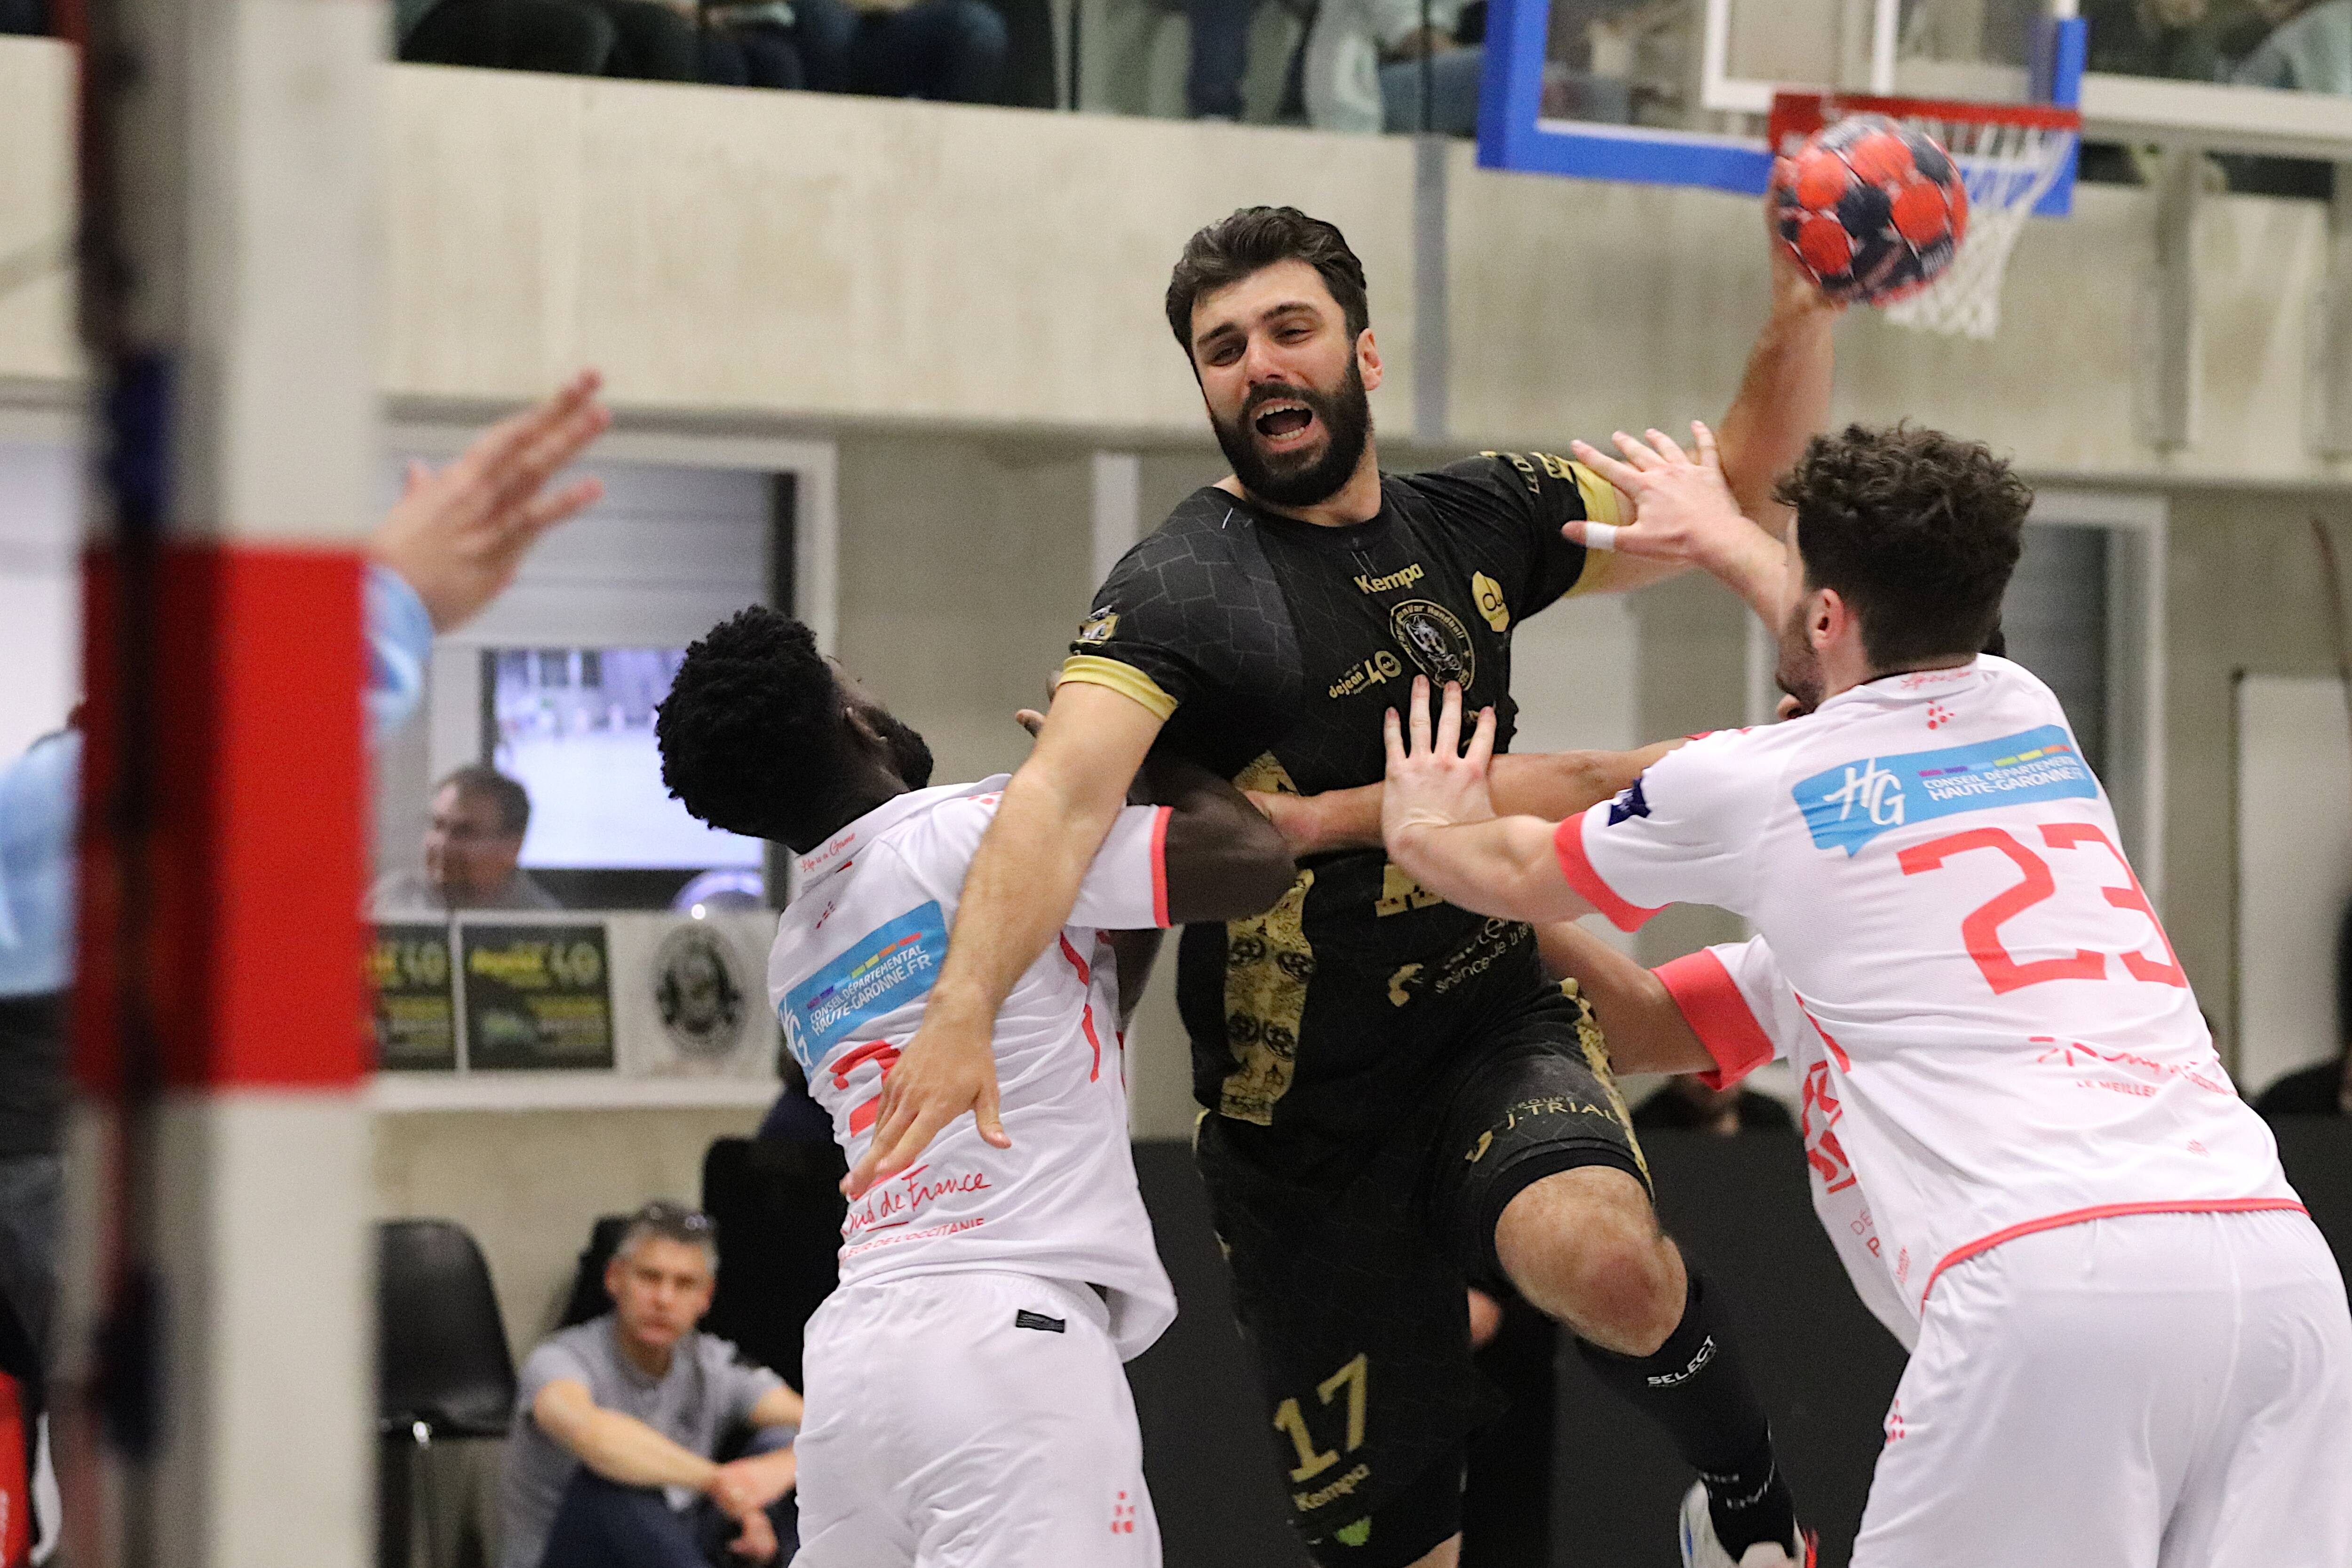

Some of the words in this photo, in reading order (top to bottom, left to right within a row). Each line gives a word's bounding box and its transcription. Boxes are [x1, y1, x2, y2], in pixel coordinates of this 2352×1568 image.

[1353, 564, 1425, 594] Kempa
[1328, 671, 1365, 699] dejean
[1364, 650, 1402, 684] 40
[1822, 758, 1906, 825] HG
[1923, 774, 1984, 790] CONSEIL
[1897, 822, 2189, 995] 23
[810, 993, 845, 1025] CONSEIL
[842, 944, 926, 1000] DÉPARTEMENTAL
[811, 954, 933, 1037] HAUTE-GARONNE.FR
[881, 1191, 906, 1218] de
[901, 1164, 992, 1212] France
[1647, 1335, 1715, 1386] SELECT
[1273, 1352, 1367, 1483] 17
